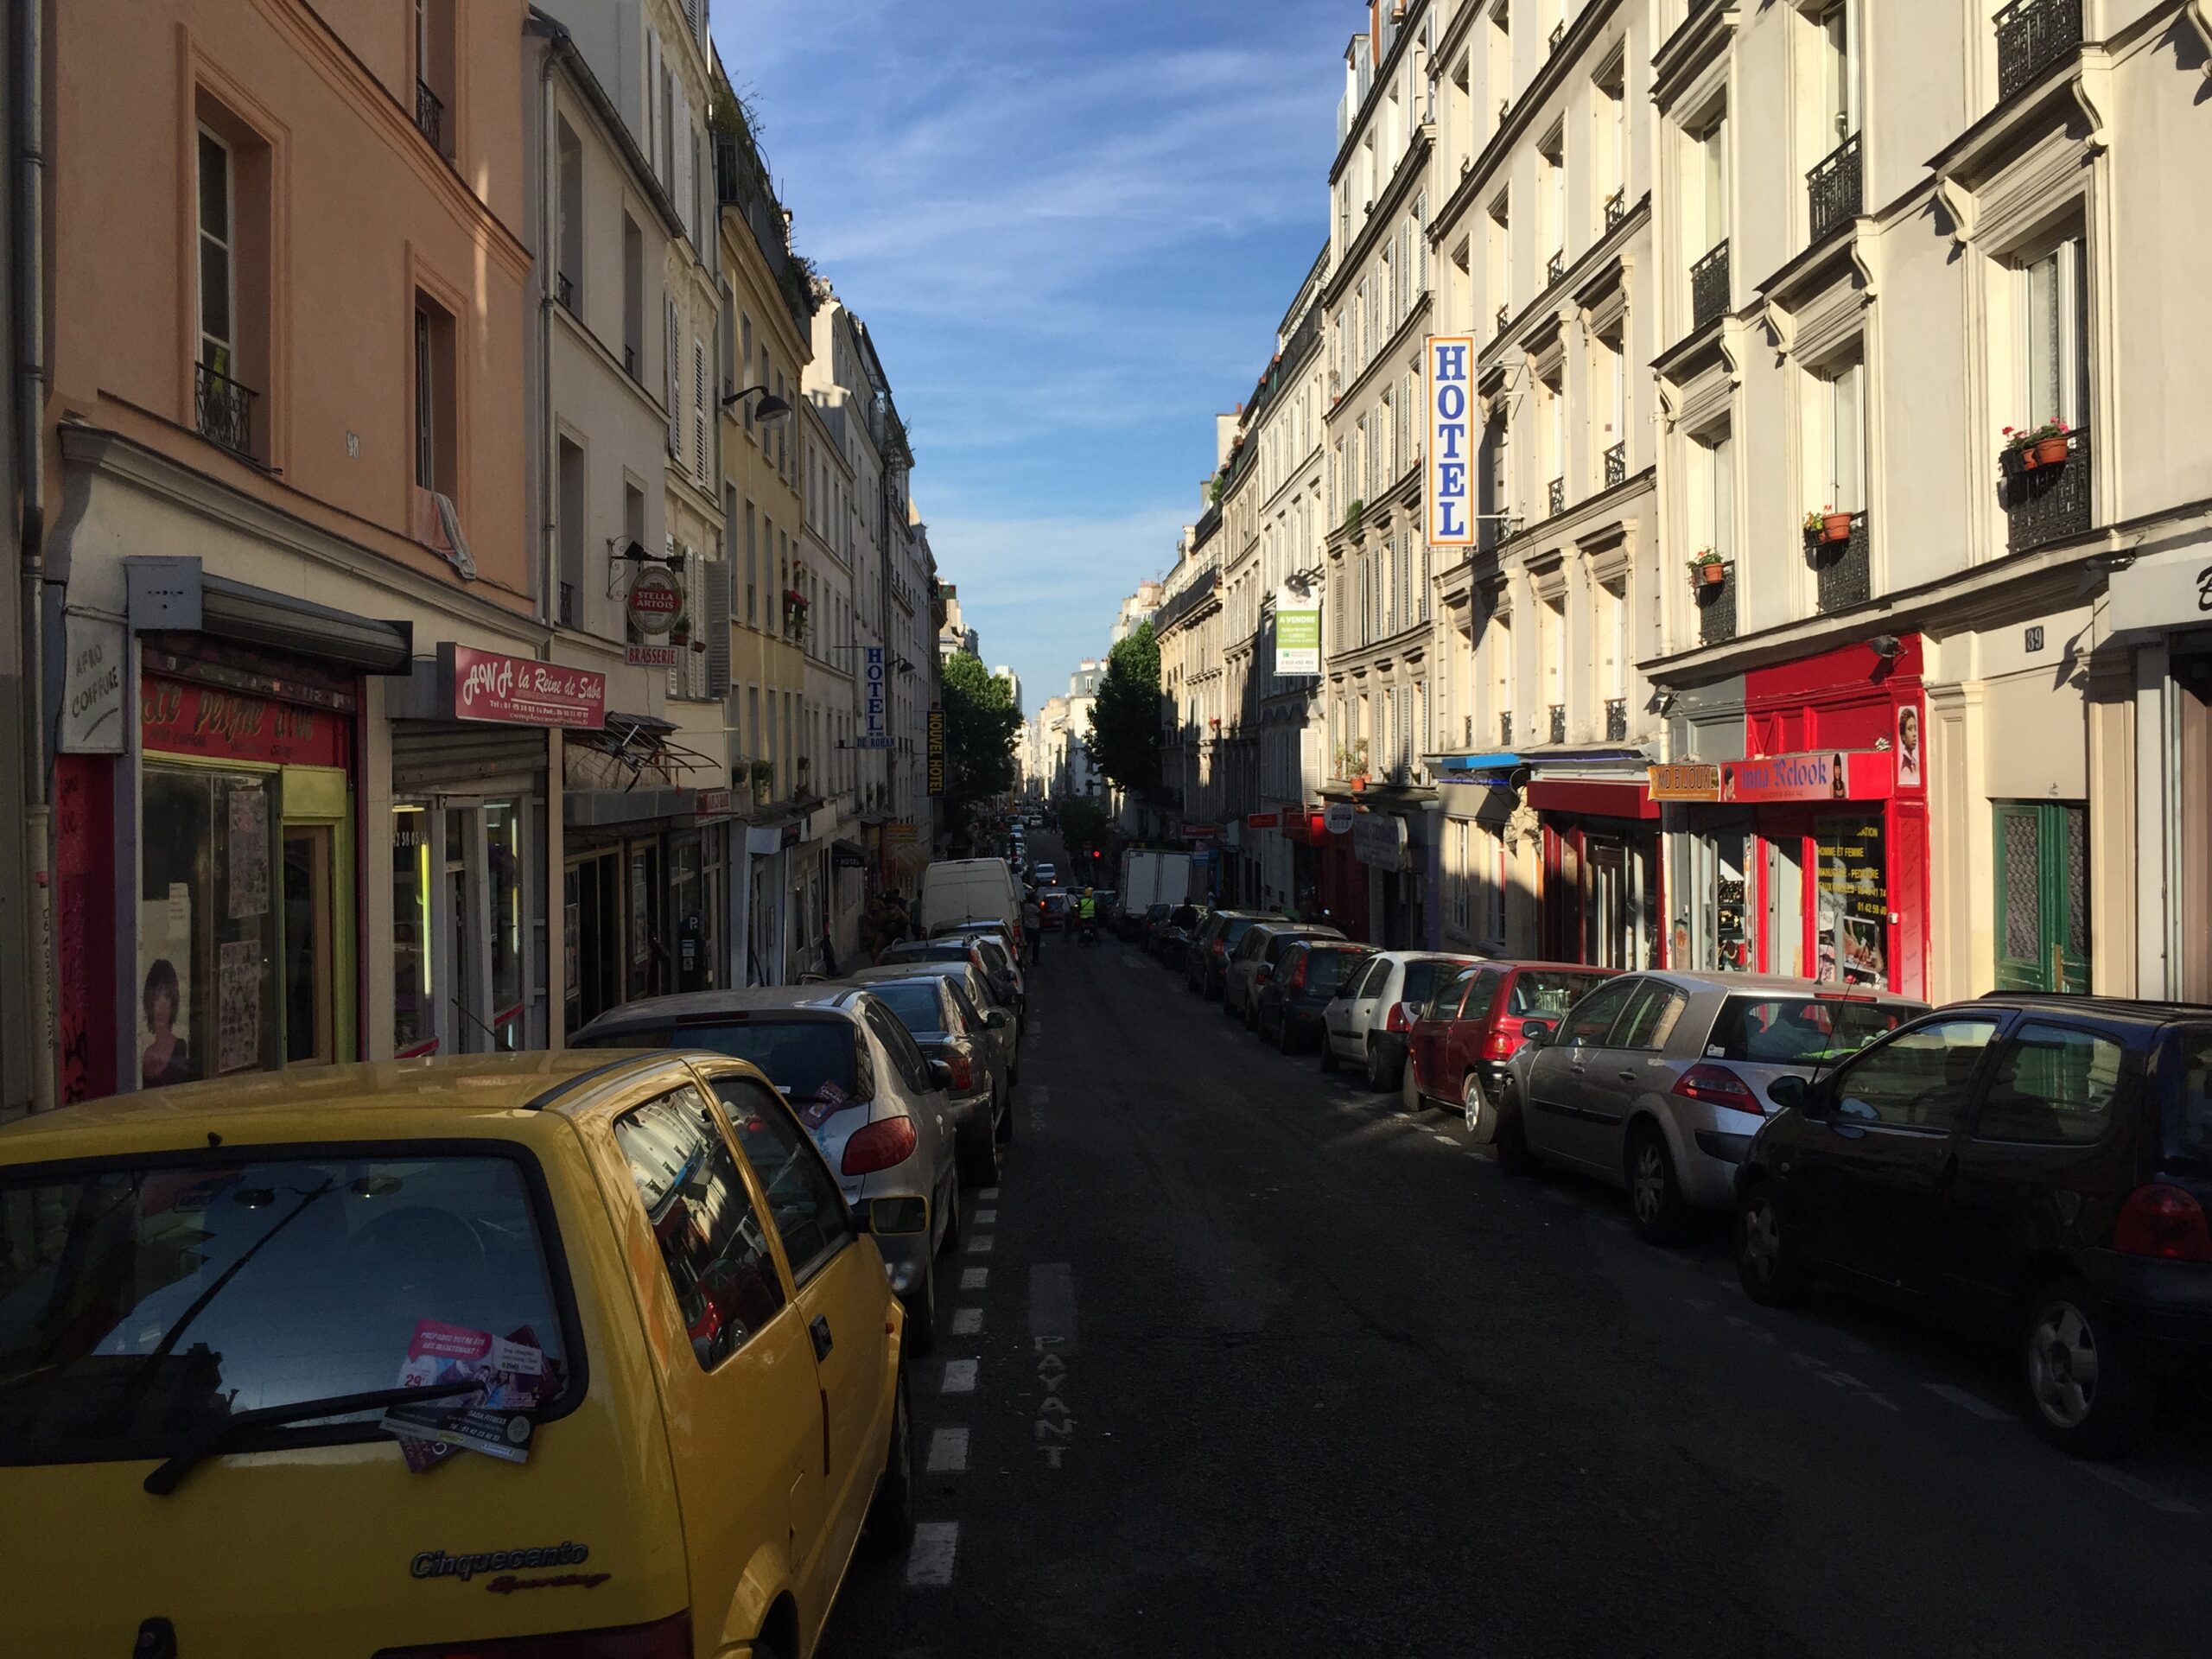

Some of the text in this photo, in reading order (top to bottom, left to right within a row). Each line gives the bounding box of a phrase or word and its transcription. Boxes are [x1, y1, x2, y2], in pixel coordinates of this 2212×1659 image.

[1434, 346, 1467, 537] HOTEL
[636, 600, 675, 609] ARTOIS
[638, 591, 674, 601] STELLA
[1286, 615, 1316, 624] VENDRE
[75, 644, 102, 678] AFRO
[628, 647, 676, 664] BRASSERIE
[71, 665, 119, 719] COIFFURE
[462, 659, 513, 706] AWA
[518, 665, 531, 690] la
[533, 667, 563, 694] Reine
[563, 675, 576, 696] de
[577, 677, 602, 700] Saba
[867, 648, 884, 731] HOTEL
[856, 737, 896, 748] DE ROHAN
[929, 713, 943, 757] NOUVEL
[1837, 847, 1844, 857] ET
[689, 916, 699, 930] P
[410, 1541, 589, 1582] Cinquecento
